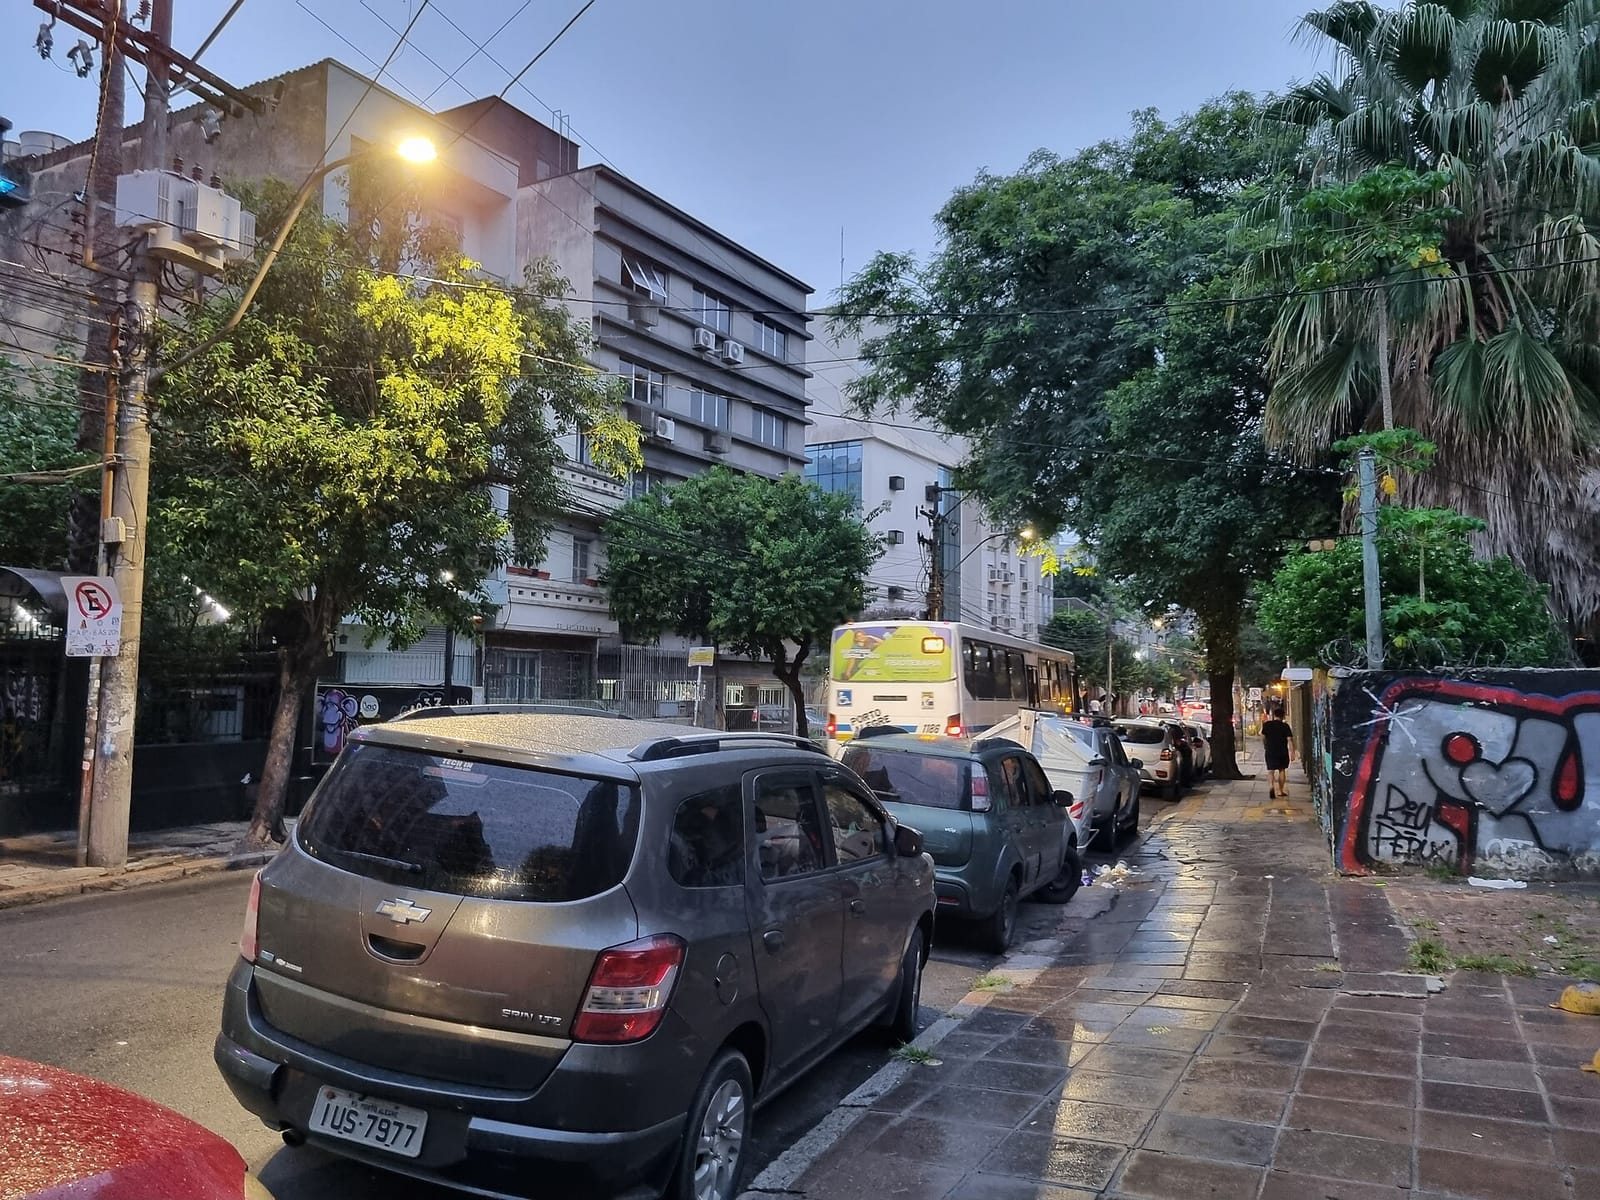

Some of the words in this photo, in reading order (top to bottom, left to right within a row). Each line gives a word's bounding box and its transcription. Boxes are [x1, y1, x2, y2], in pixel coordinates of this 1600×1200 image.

[850, 709, 881, 725] PORTO
[502, 1008, 534, 1021] SPIN
[538, 1014, 562, 1026] LTZ
